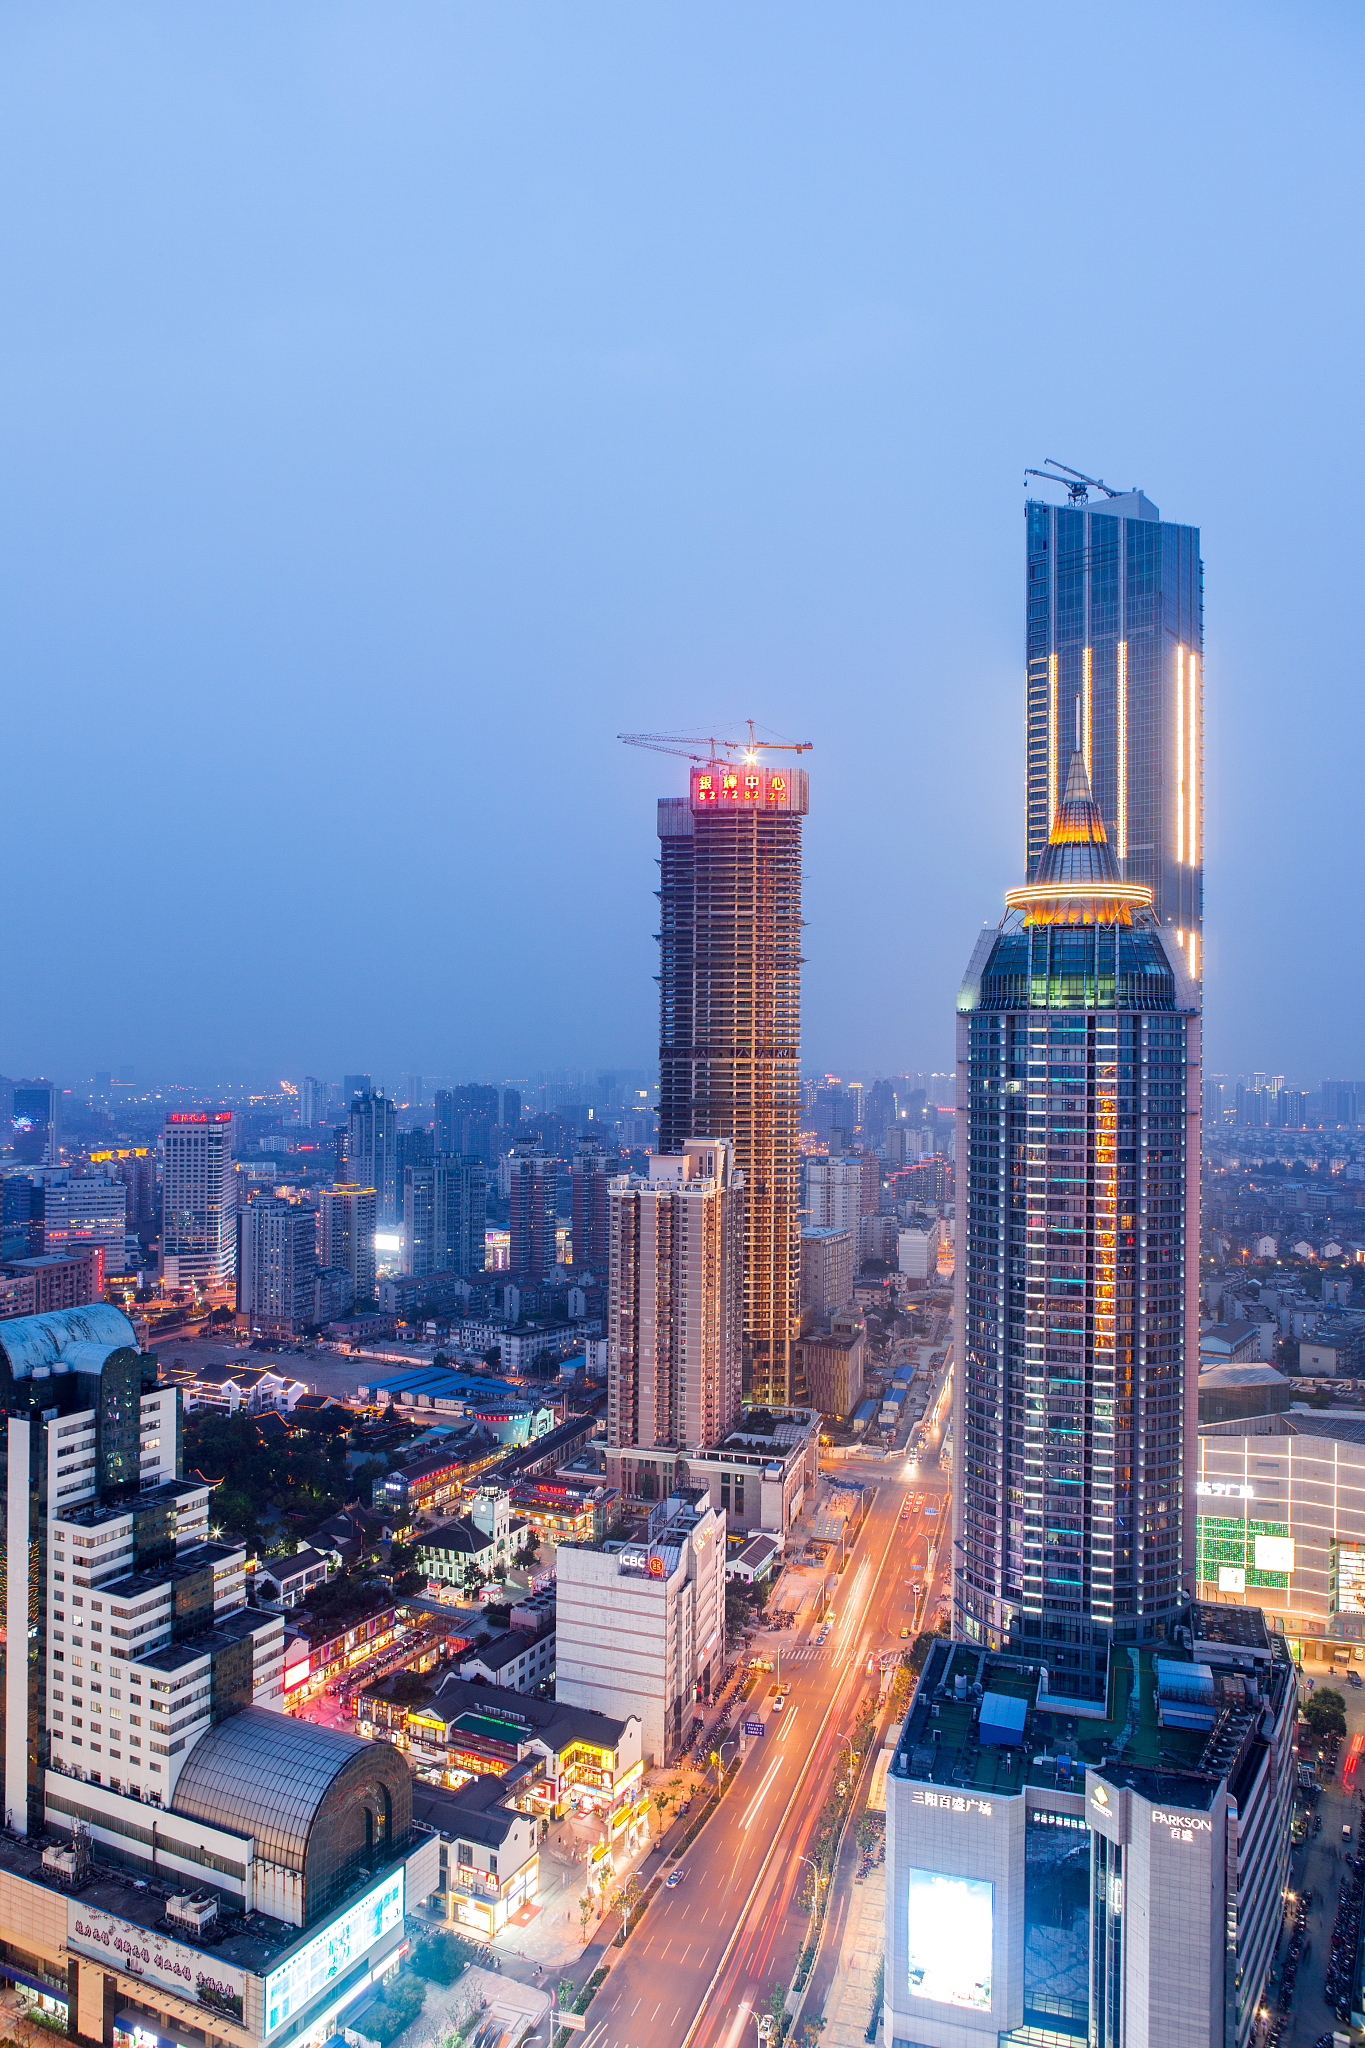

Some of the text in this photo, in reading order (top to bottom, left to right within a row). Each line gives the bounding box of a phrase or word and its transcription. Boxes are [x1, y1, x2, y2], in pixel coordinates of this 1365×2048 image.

[619, 1554, 646, 1568] ICBC
[463, 1752, 479, 1762] KFC
[580, 1766, 597, 1775] KFC
[911, 1791, 992, 1816] 三阳百盛广场
[1152, 1810, 1212, 1832] PARKSON
[1169, 1826, 1194, 1842] 百盛
[114, 1936, 150, 1963] 创新无锡
[153, 1953, 192, 1981] 创业无锡
